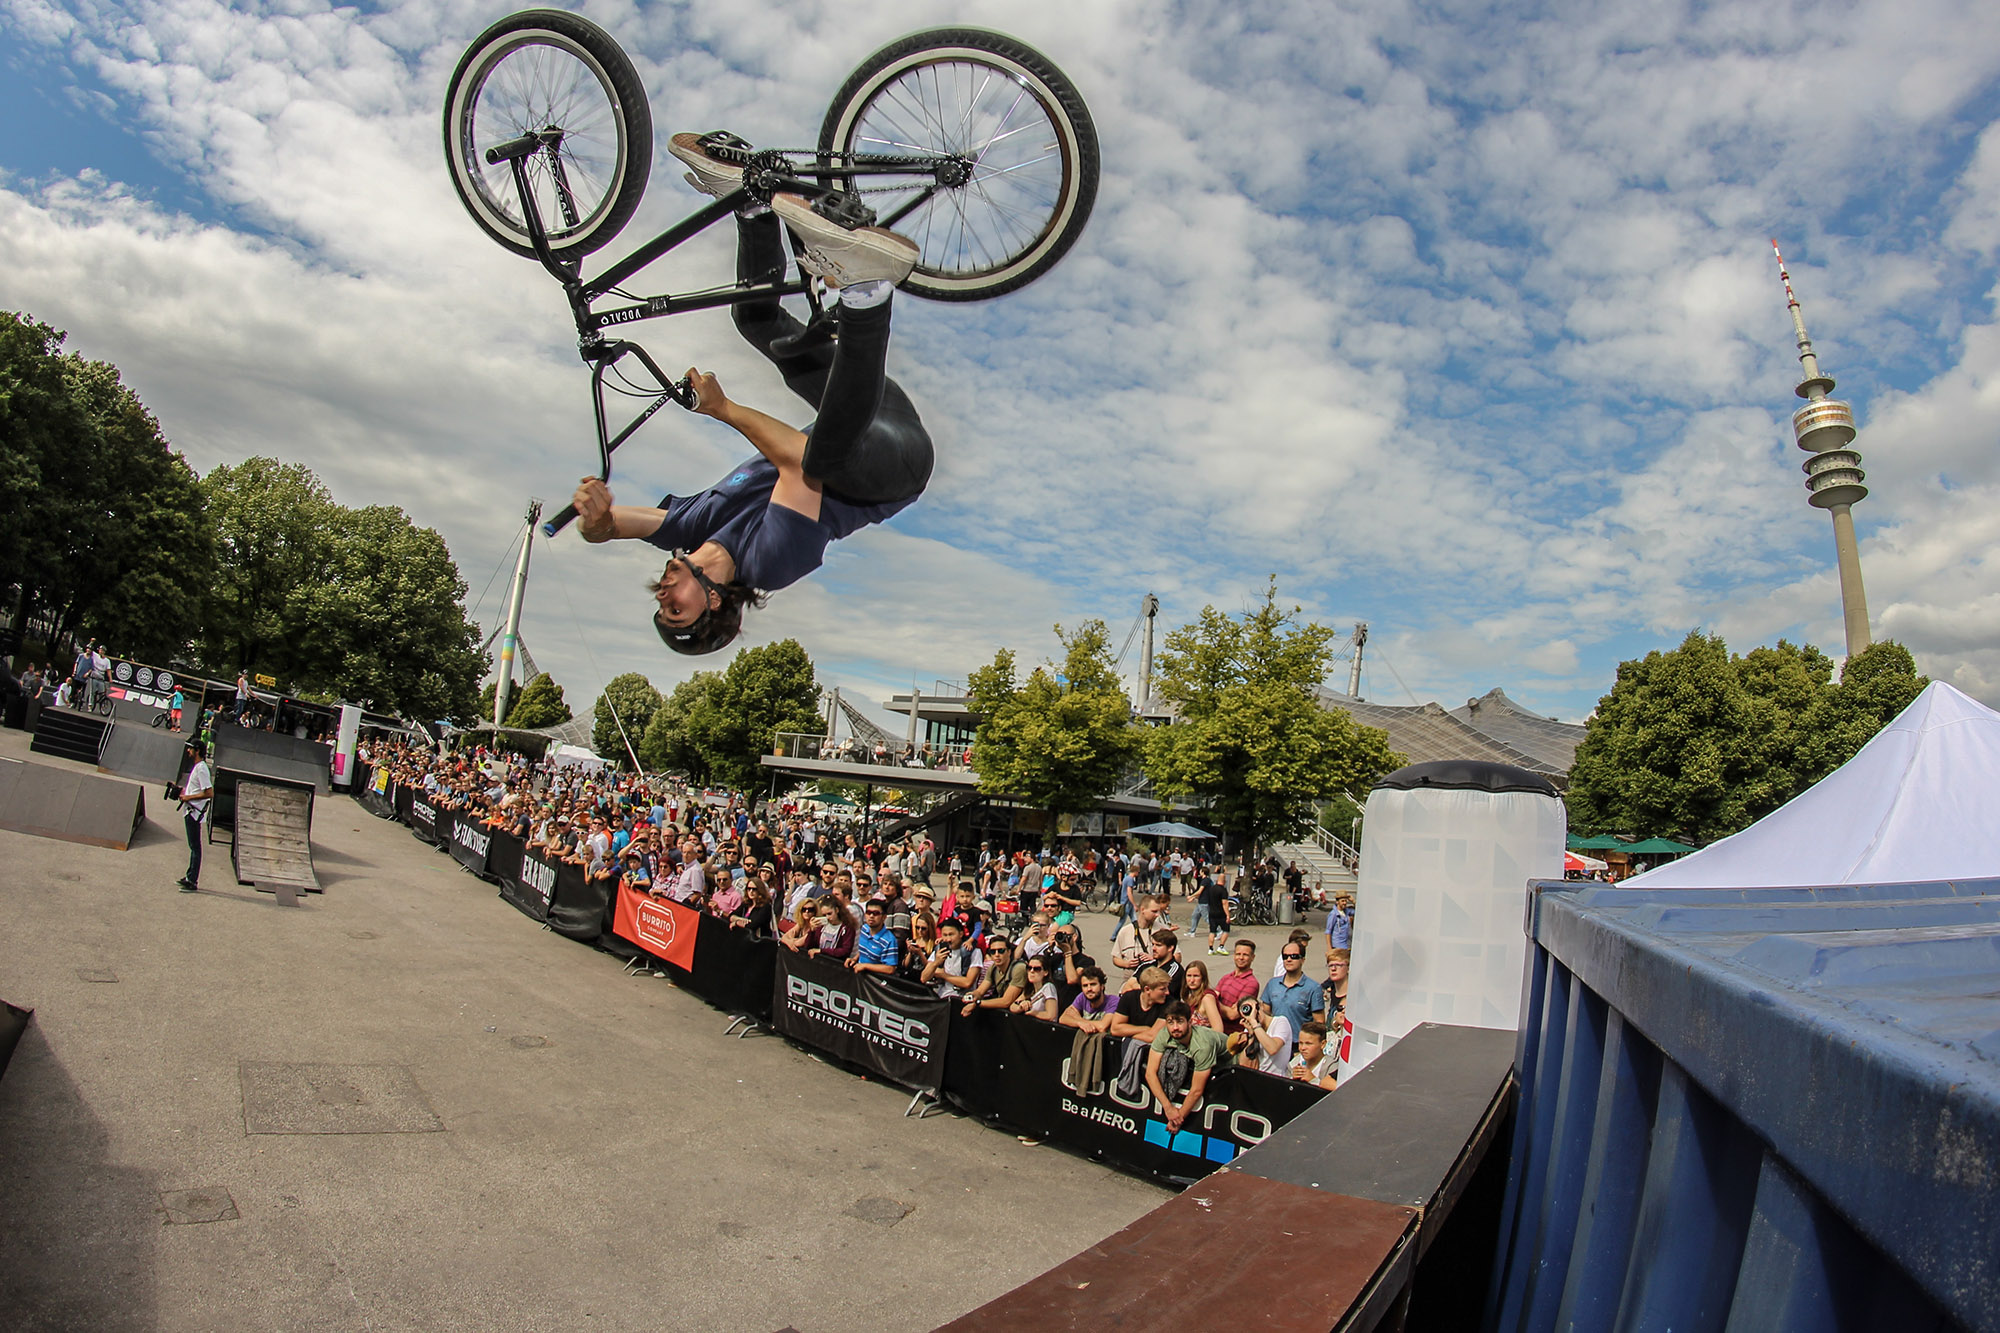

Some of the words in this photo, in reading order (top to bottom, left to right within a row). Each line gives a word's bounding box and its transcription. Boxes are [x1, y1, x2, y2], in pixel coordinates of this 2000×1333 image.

[609, 308, 642, 324] VOCAL
[531, 863, 539, 888] &
[642, 911, 671, 932] BURRITO
[786, 974, 930, 1048] PRO-TEC
[787, 1001, 803, 1014] THE
[808, 1010, 855, 1034] ORIGINAL
[861, 1030, 893, 1050] SINCE
[901, 1047, 929, 1063] 1973
[1062, 1098, 1079, 1115] Be
[1080, 1107, 1089, 1118] a
[1090, 1106, 1138, 1135] HERO.
